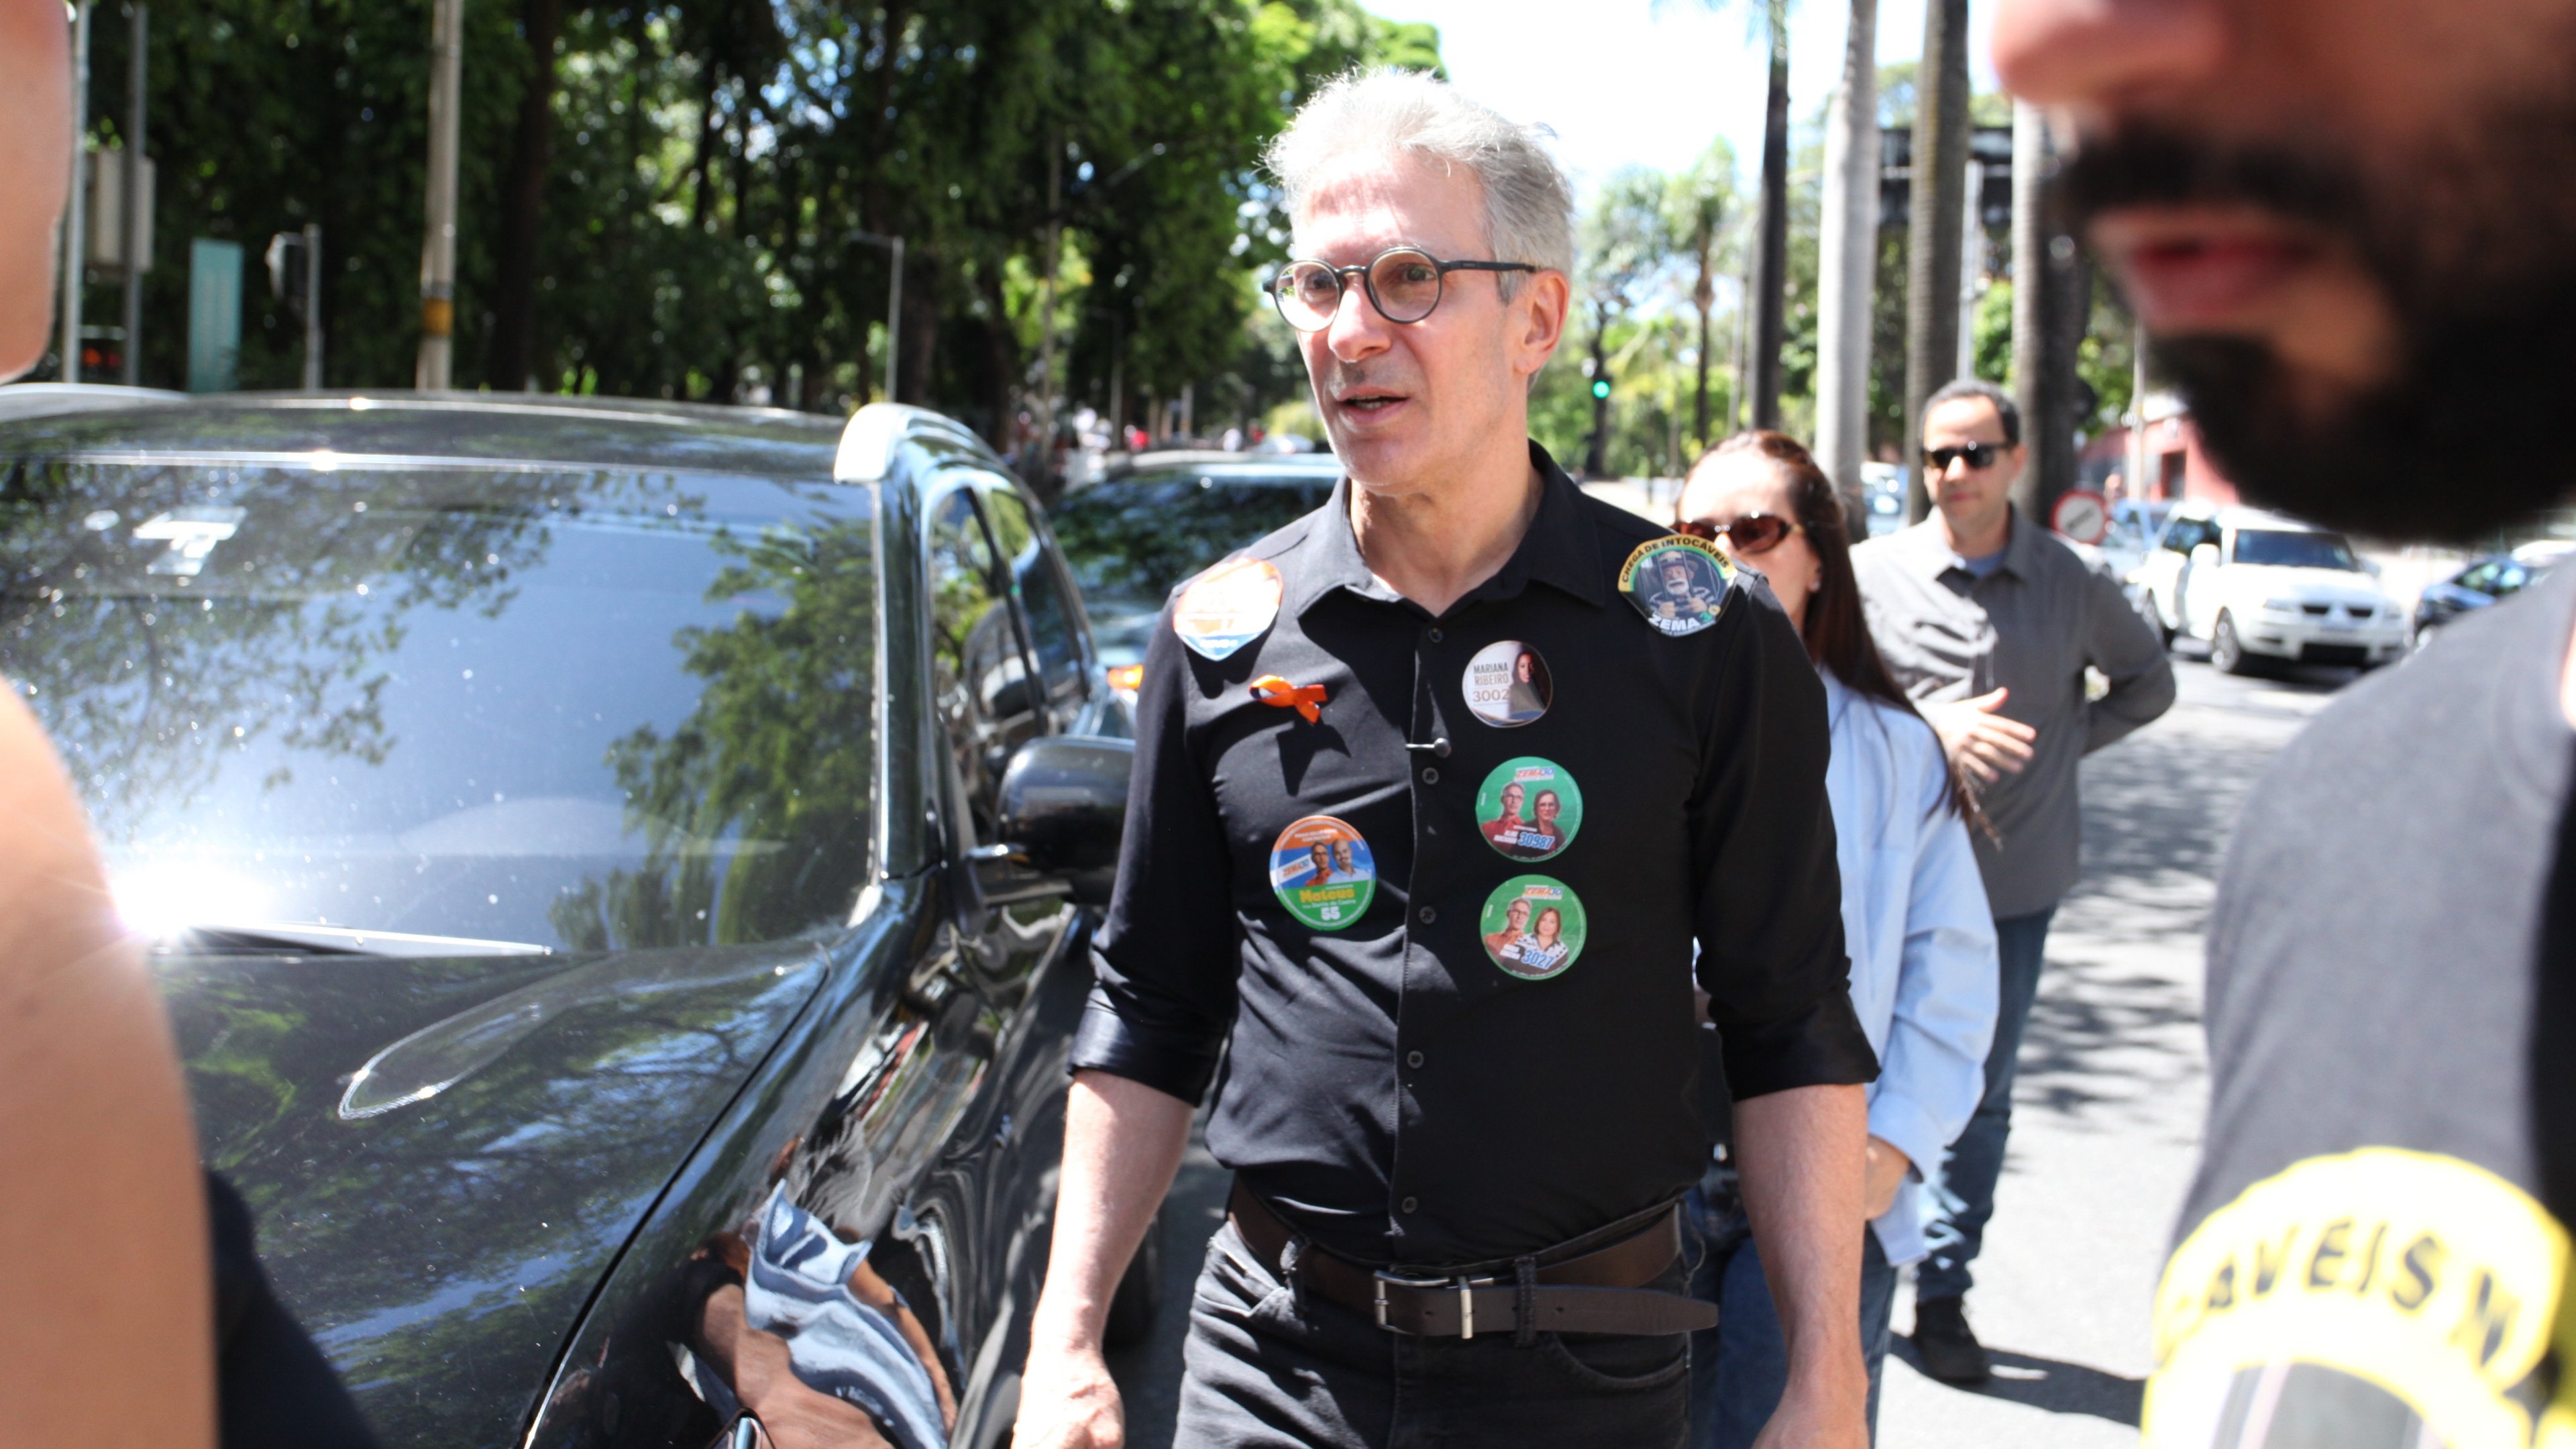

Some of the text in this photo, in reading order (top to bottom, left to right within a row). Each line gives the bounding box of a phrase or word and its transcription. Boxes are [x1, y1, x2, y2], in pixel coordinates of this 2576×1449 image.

[1622, 537, 1729, 582] CHEGA DE INTOCÁVEIS
[1648, 612, 1701, 631] ZEMA
[1473, 662, 1509, 674] MARIANA
[1474, 673, 1509, 686] RIBEIRO
[1472, 689, 1509, 702] 3002
[1519, 833, 1554, 849] 30987
[1523, 949, 1555, 969] 3027
